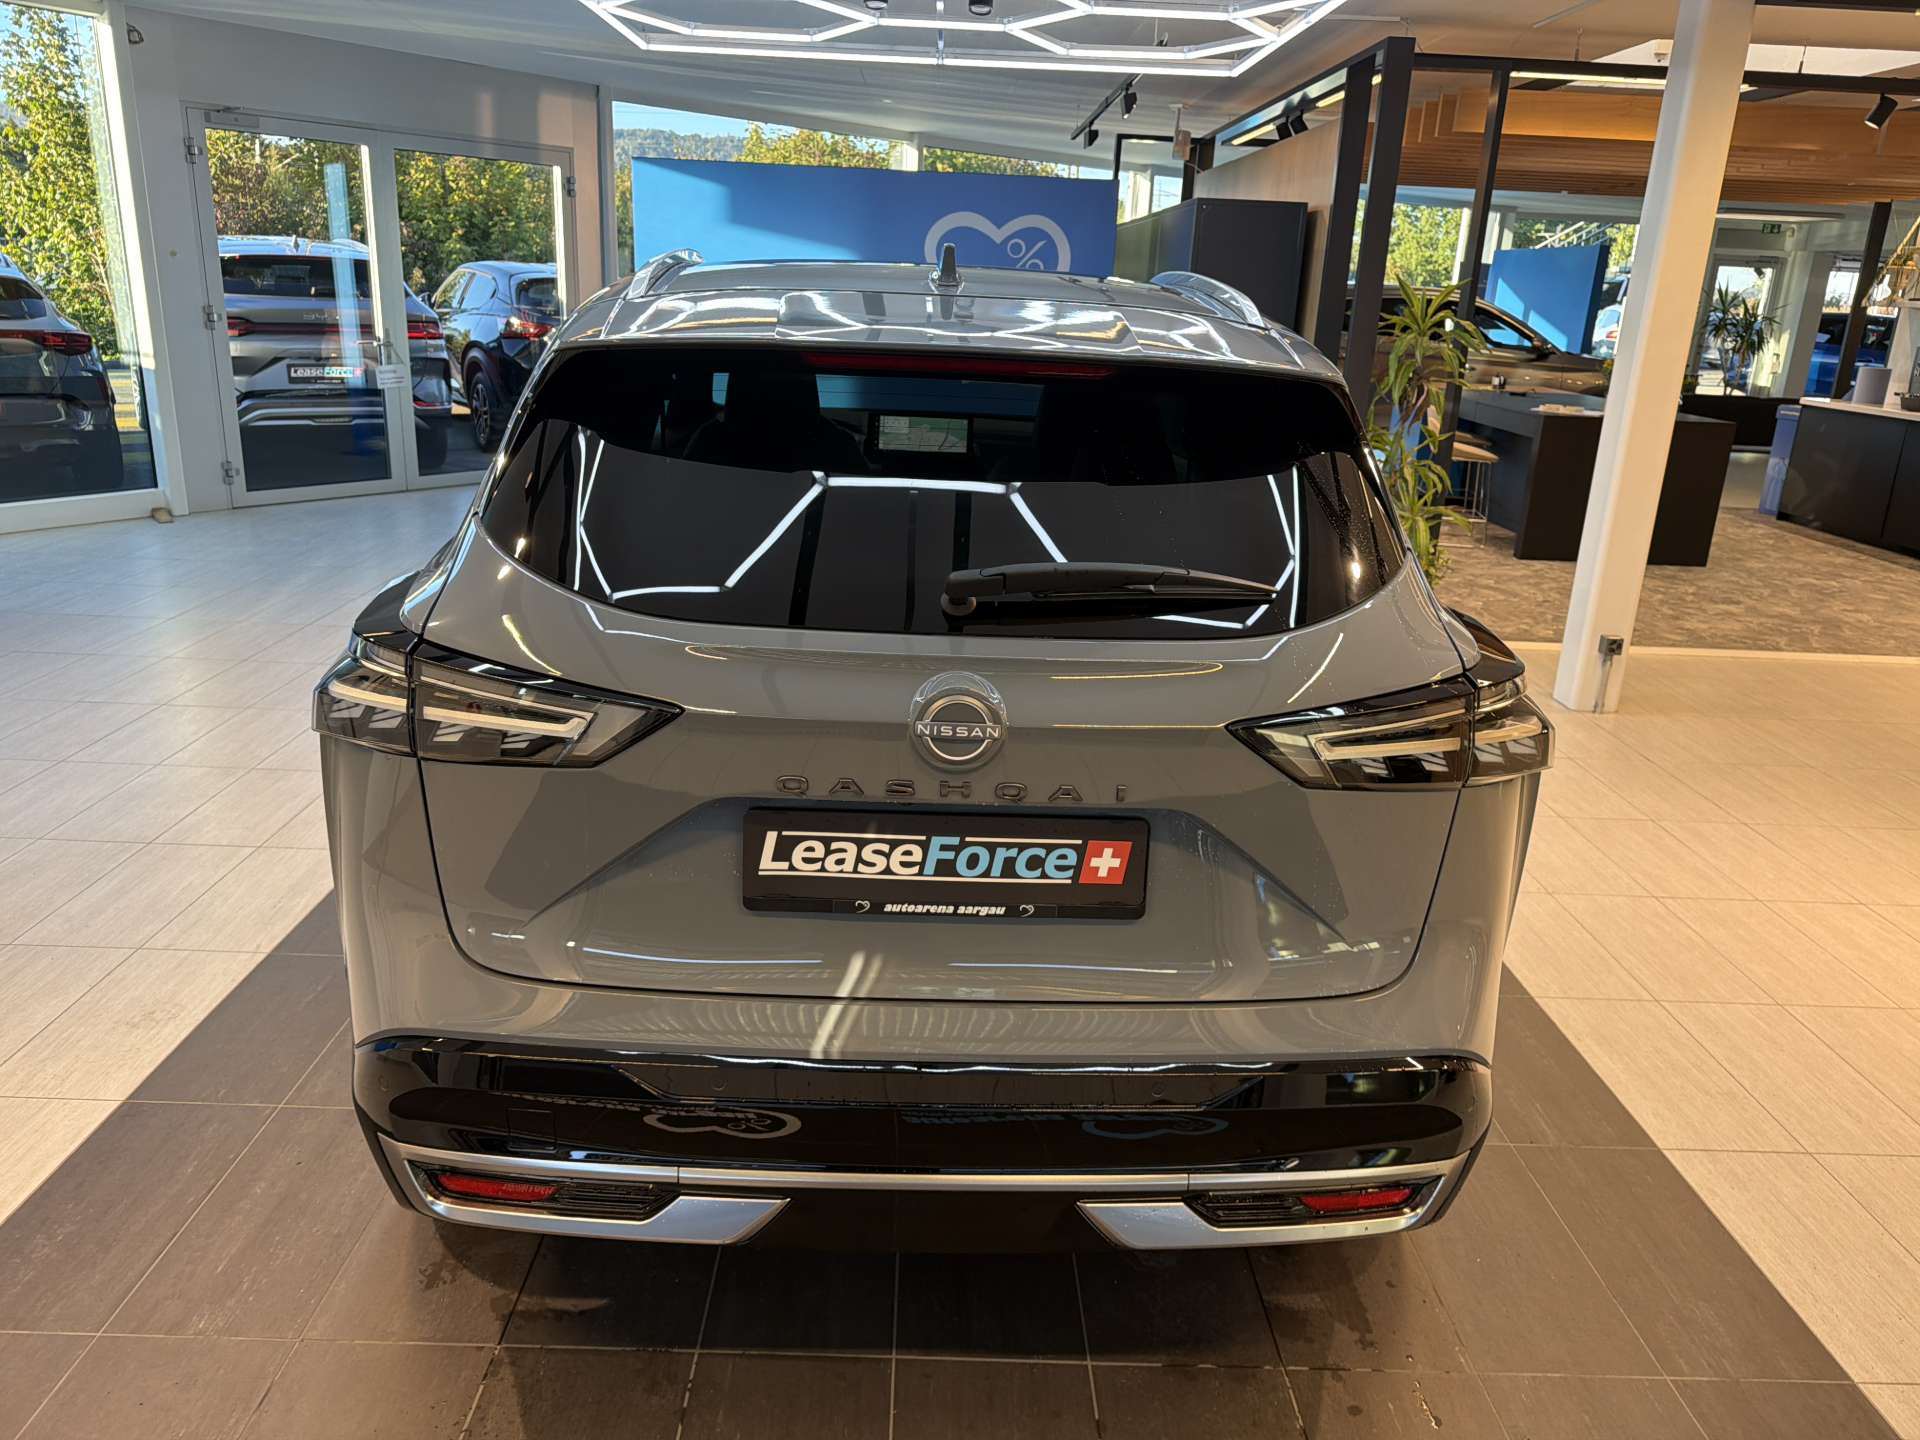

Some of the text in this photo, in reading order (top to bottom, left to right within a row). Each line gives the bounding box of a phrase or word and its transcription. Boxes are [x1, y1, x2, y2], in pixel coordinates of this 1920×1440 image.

[917, 723, 1000, 738] NISSAN
[775, 774, 1128, 804] QASHQAI
[758, 830, 1079, 879] LeaseForce
[883, 903, 1006, 917] autoarena aargau
